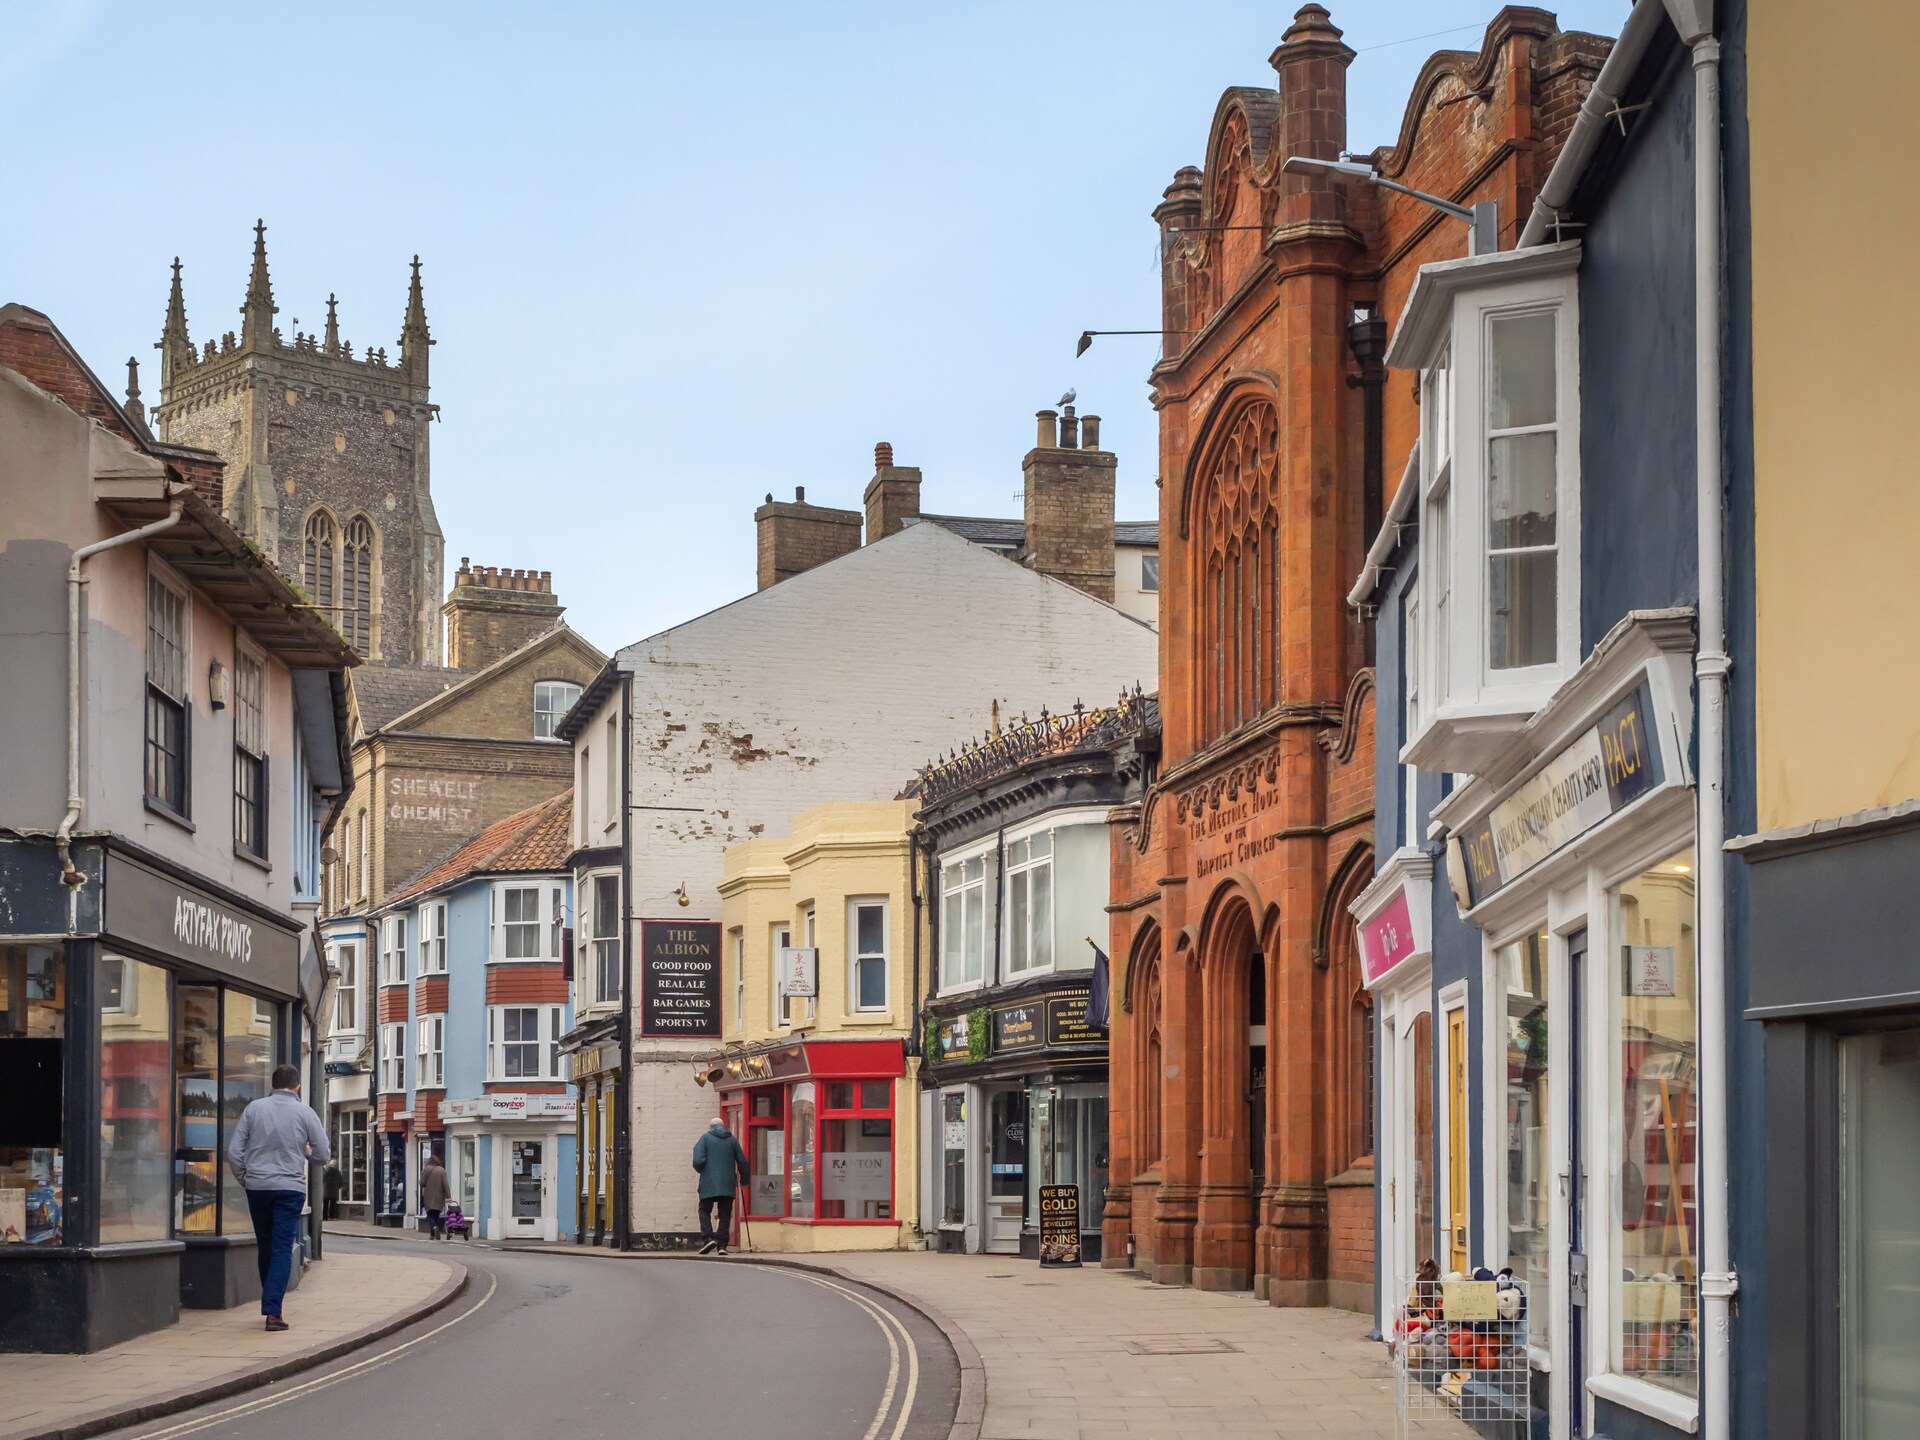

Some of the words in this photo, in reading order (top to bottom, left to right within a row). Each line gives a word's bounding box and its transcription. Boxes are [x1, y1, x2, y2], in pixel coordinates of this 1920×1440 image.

[1603, 710, 1642, 787] PACT
[1252, 788, 1279, 814] HOUS
[390, 804, 472, 820] CHEMIST
[1496, 815, 1521, 861] ANIMAL
[1516, 790, 1554, 845] SANCTUARY
[1551, 769, 1584, 819] CHARITY
[1581, 754, 1602, 798] SHOP
[1469, 831, 1495, 883] PACT
[174, 895, 220, 952] ARTYFAX
[221, 914, 252, 963] PRINTS
[667, 929, 697, 941] THE
[654, 943, 710, 955] ALBION
[652, 961, 682, 970] GOOD
[684, 962, 712, 970] FOOD
[658, 980, 685, 988] REAL
[686, 980, 706, 989] ALE
[653, 999, 674, 1008] BAR
[675, 999, 711, 1008] GAMES
[655, 1018, 692, 1027] SPORTS
[694, 1019, 708, 1027] TV
[492, 1101, 526, 1109] copyshop
[1042, 1189, 1056, 1197] WE
[1058, 1189, 1075, 1197] BUY
[1042, 1199, 1077, 1211] GOLD
[1042, 1234, 1078, 1245] COINS
